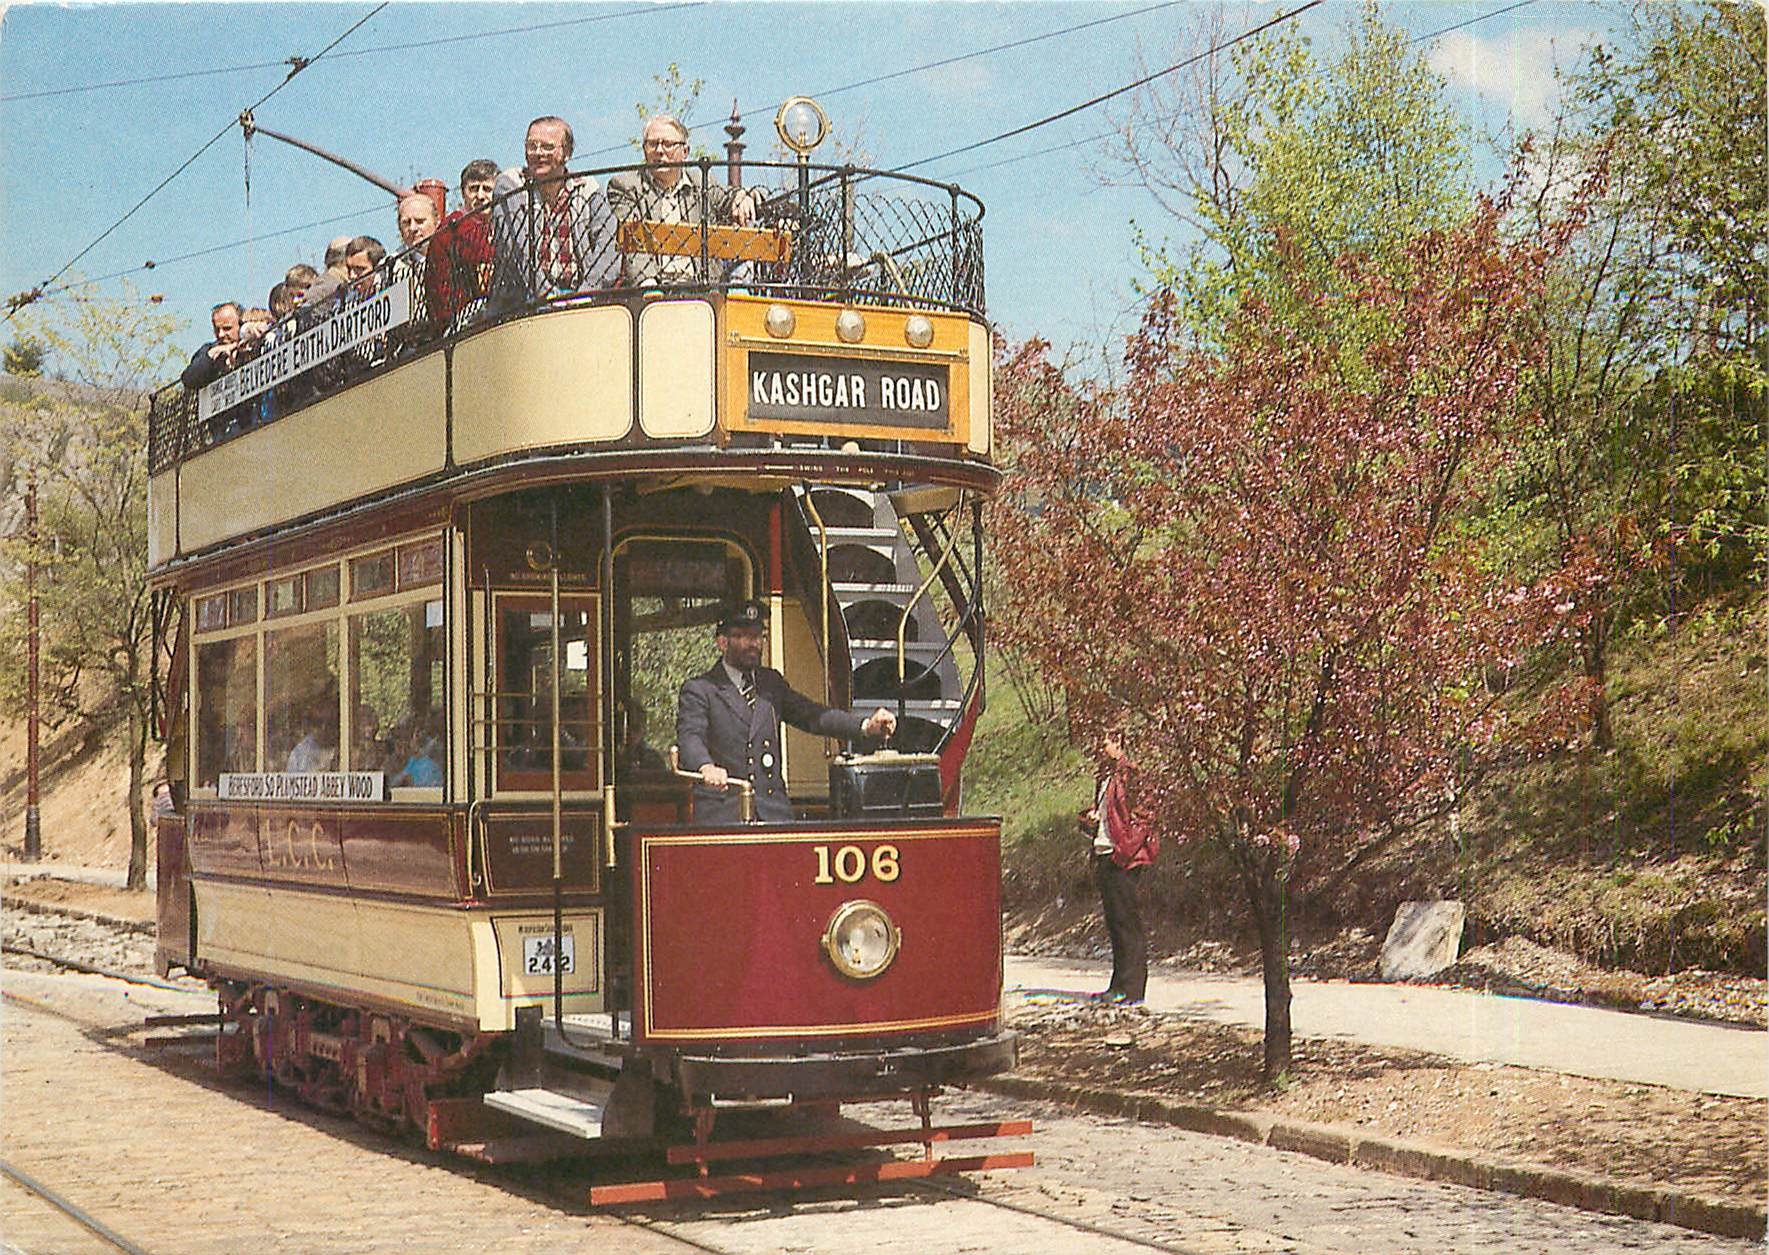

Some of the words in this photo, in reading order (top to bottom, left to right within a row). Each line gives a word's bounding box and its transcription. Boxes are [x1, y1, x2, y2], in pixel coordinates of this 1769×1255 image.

[240, 348, 289, 397] BELVEDERE
[293, 328, 325, 370] ERITH
[330, 295, 391, 351] DARTFORD
[752, 371, 866, 409] KASHGAR
[881, 376, 941, 412] ROAD
[228, 774, 264, 797] BERESFORD
[275, 774, 319, 799] PLUMSTEAD
[320, 774, 346, 798] ABBEY
[348, 774, 374, 799] WOOD
[813, 844, 901, 884] 106
